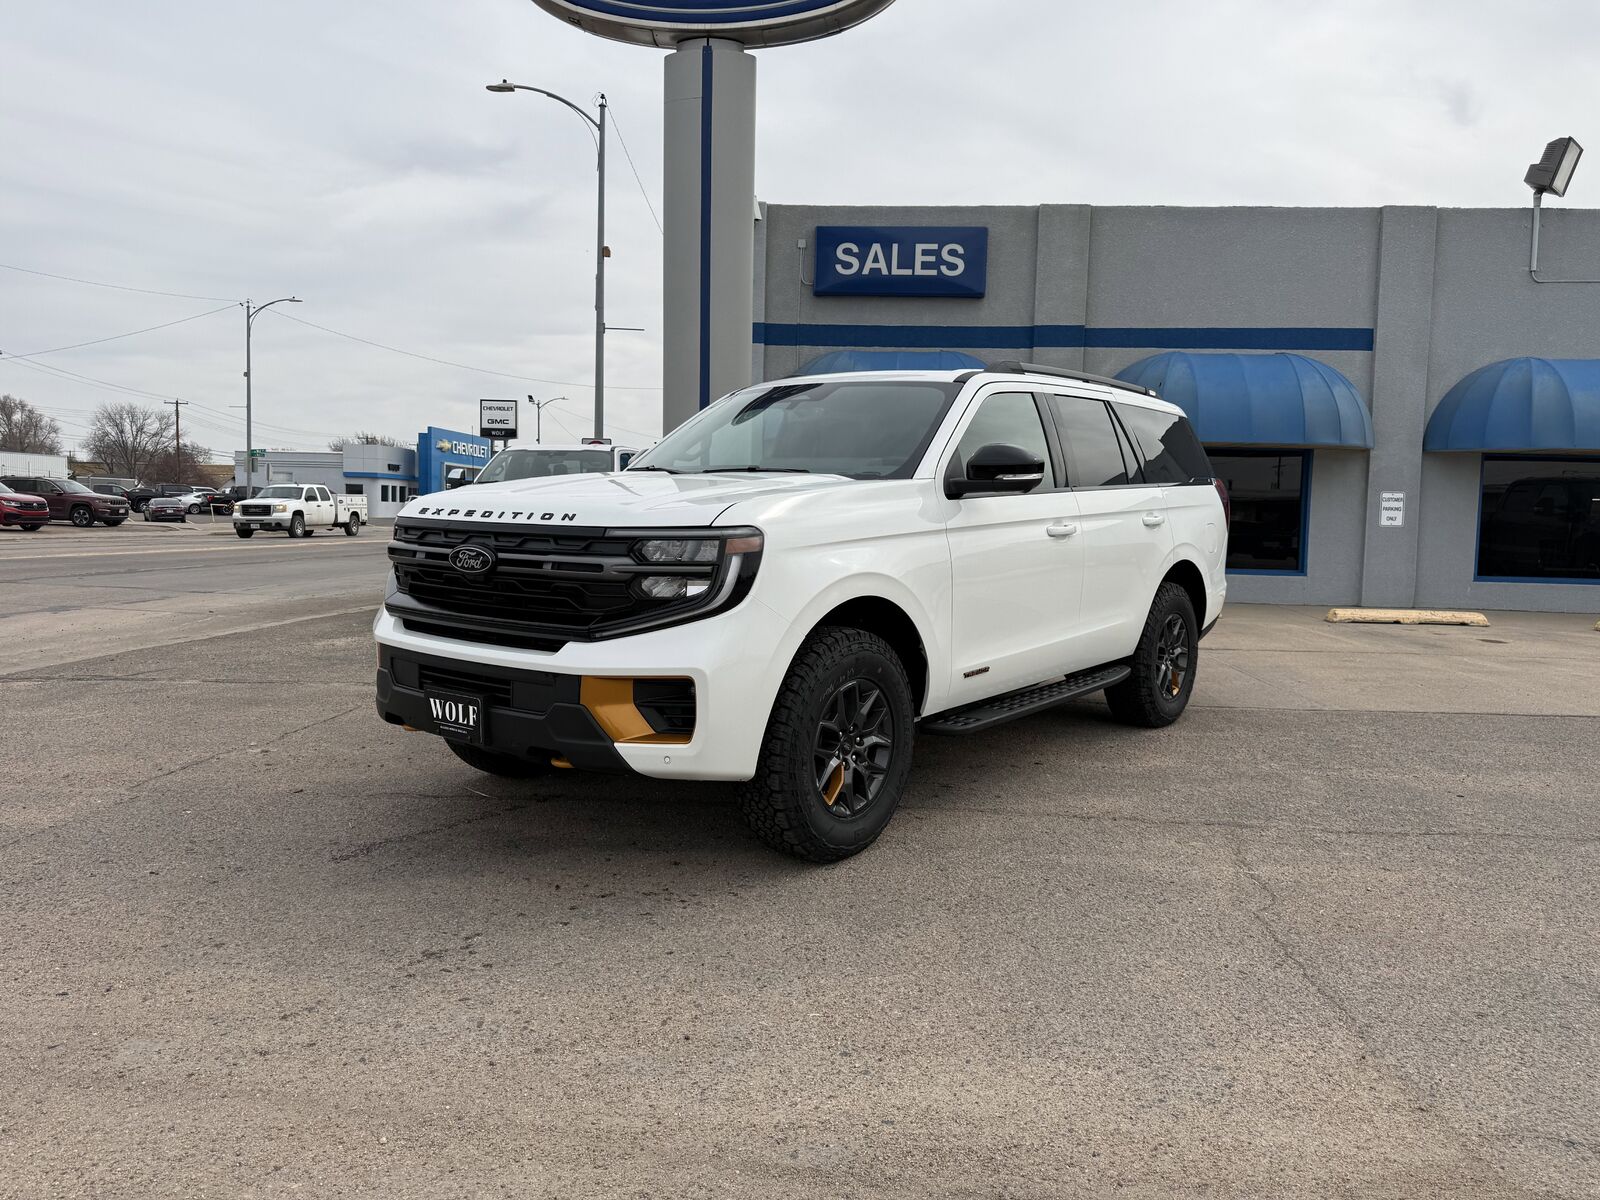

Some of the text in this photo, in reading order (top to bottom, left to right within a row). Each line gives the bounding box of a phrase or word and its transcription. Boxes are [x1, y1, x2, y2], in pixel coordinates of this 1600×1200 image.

[834, 242, 965, 277] SALES
[452, 440, 488, 459] CHEVROLET
[418, 507, 577, 521] EXPEDITION
[456, 549, 483, 569] Ford
[429, 698, 478, 726] WOLF
